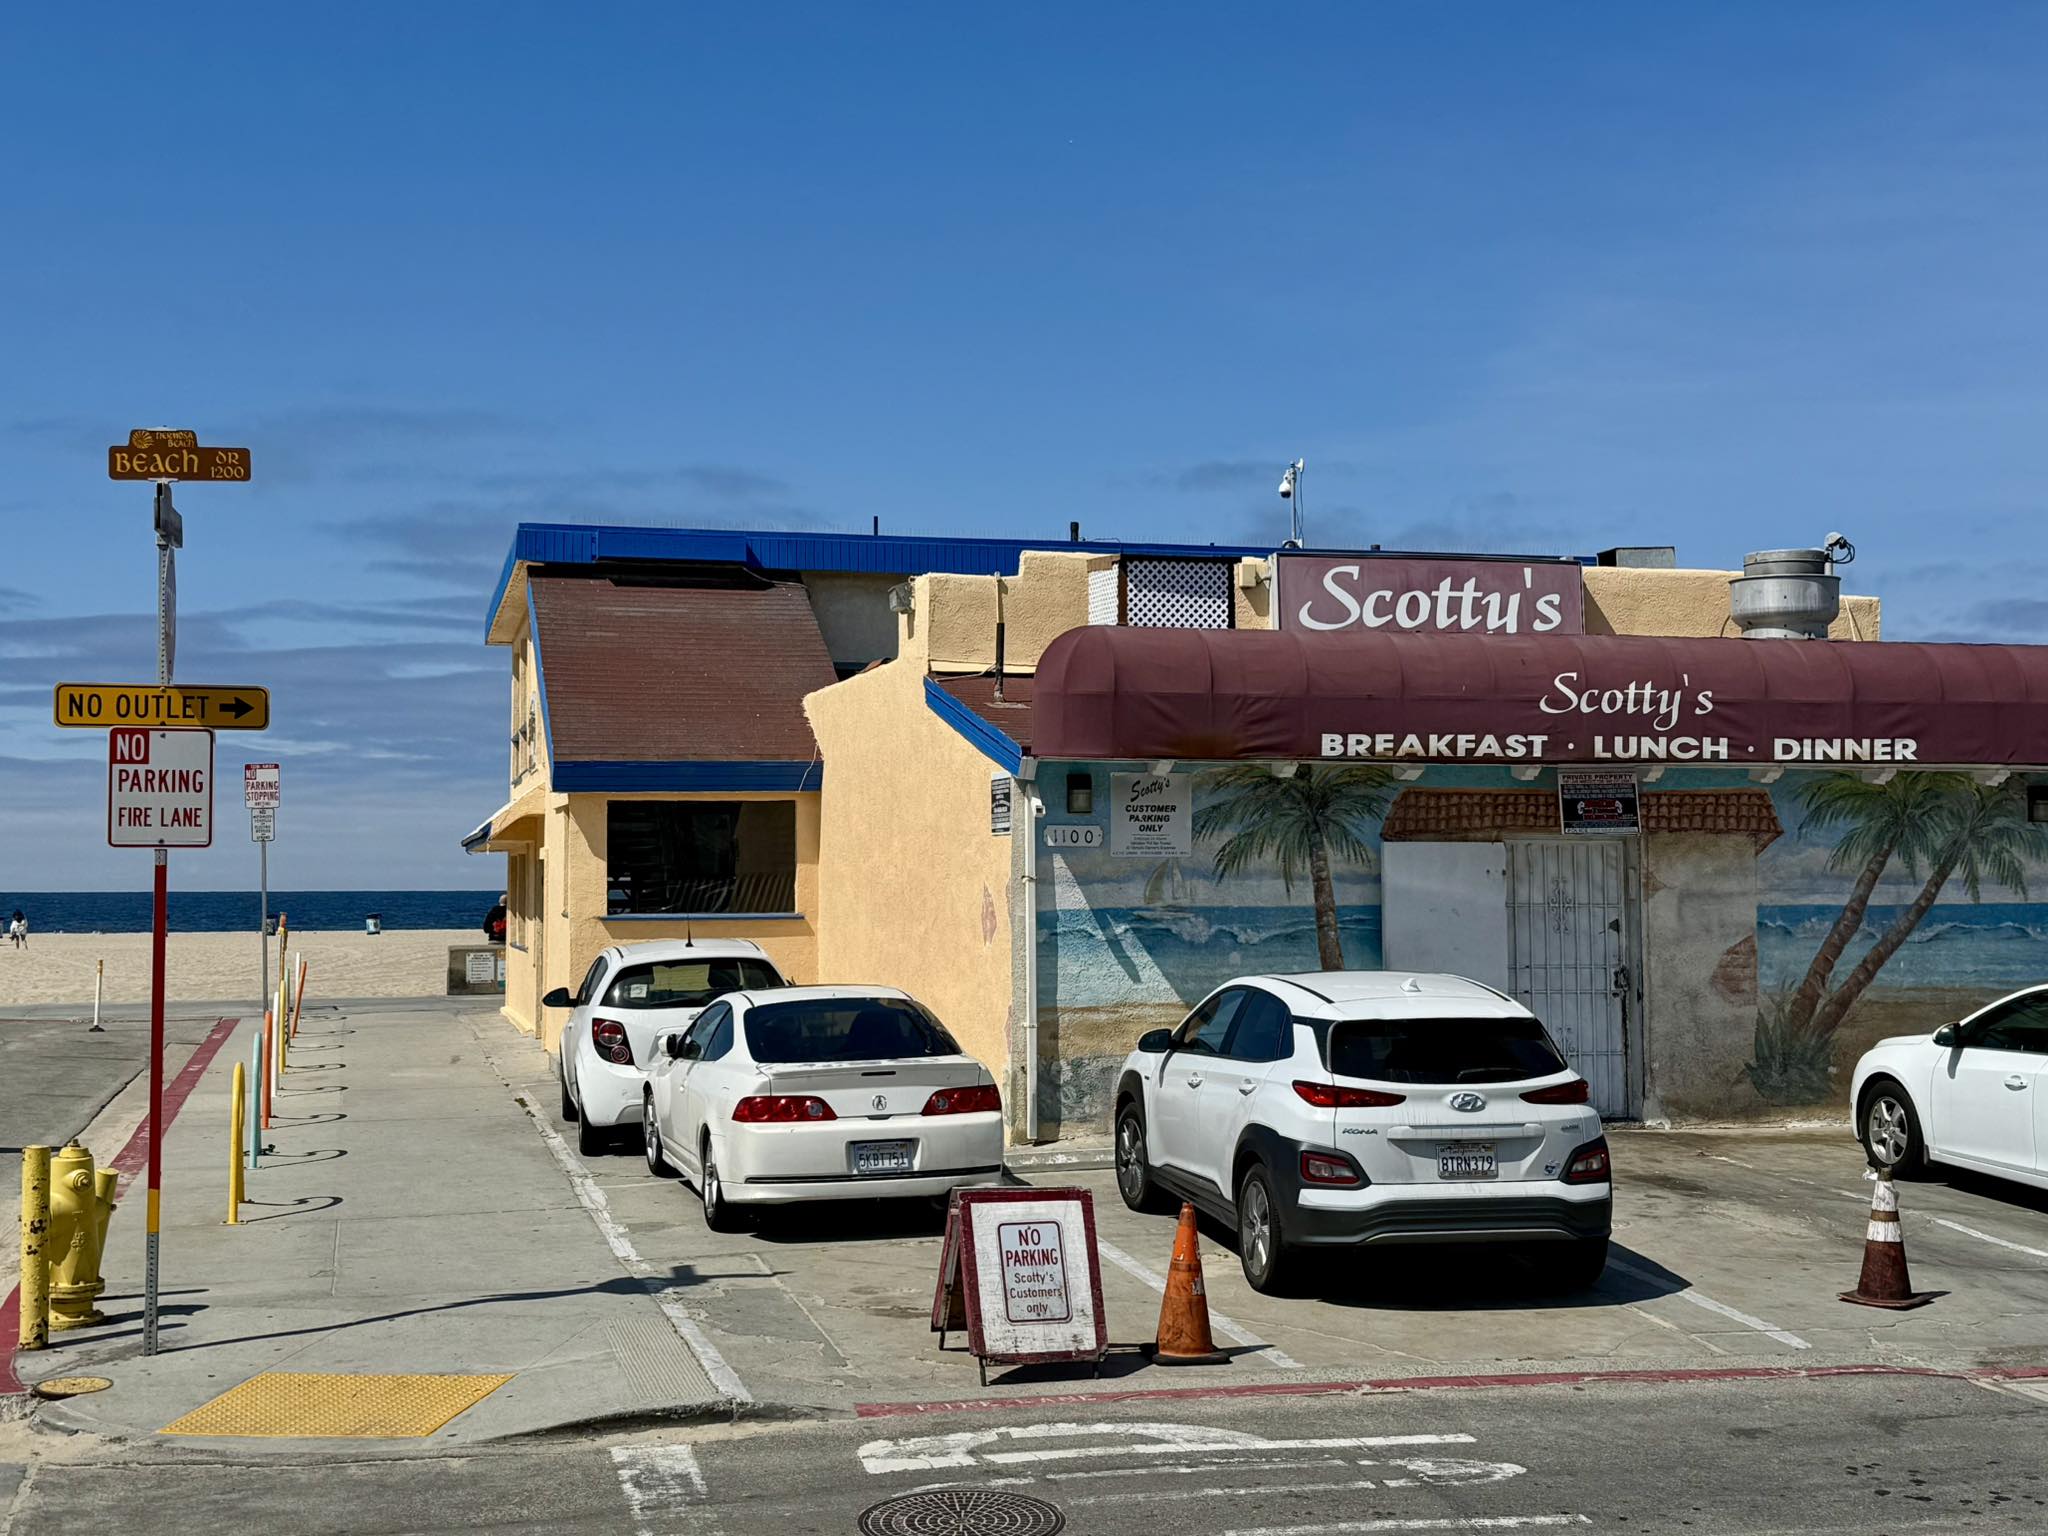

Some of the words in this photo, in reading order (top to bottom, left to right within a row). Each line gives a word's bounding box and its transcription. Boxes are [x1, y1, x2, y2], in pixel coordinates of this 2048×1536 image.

[210, 465, 245, 479] 1200
[1298, 565, 1562, 634] Scotty's
[68, 693, 103, 718] NO
[115, 694, 210, 719] OUTLET
[1539, 672, 1714, 731] Scotty's
[116, 733, 145, 761] NO
[1321, 733, 1549, 758] BREAKFAST
[1594, 736, 1729, 760] LUNCH
[1773, 738, 1918, 761] DINNER
[118, 769, 204, 793] PARKING
[246, 770, 256, 779] NO
[246, 781, 279, 791] PARKING
[1130, 776, 1171, 802] Scotty's
[246, 791, 280, 802] STOPPING
[1125, 804, 1177, 813] CUSTOMER
[118, 807, 153, 827] FIRE
[160, 807, 203, 827] LANE
[1128, 814, 1170, 823] PARKING
[1138, 824, 1164, 833] ONLY
[1053, 829, 1094, 844] 1100
[1342, 1127, 1378, 1136] KONA
[858, 1152, 907, 1167] 5KBT751
[1441, 1155, 1494, 1172] 8TRN379
[1018, 1228, 1041, 1247] NO
[1005, 1248, 1058, 1268] PARKING
[1014, 1272, 1055, 1285] Scotty's
[1010, 1287, 1063, 1299] Customers
[1026, 1303, 1049, 1314] only
